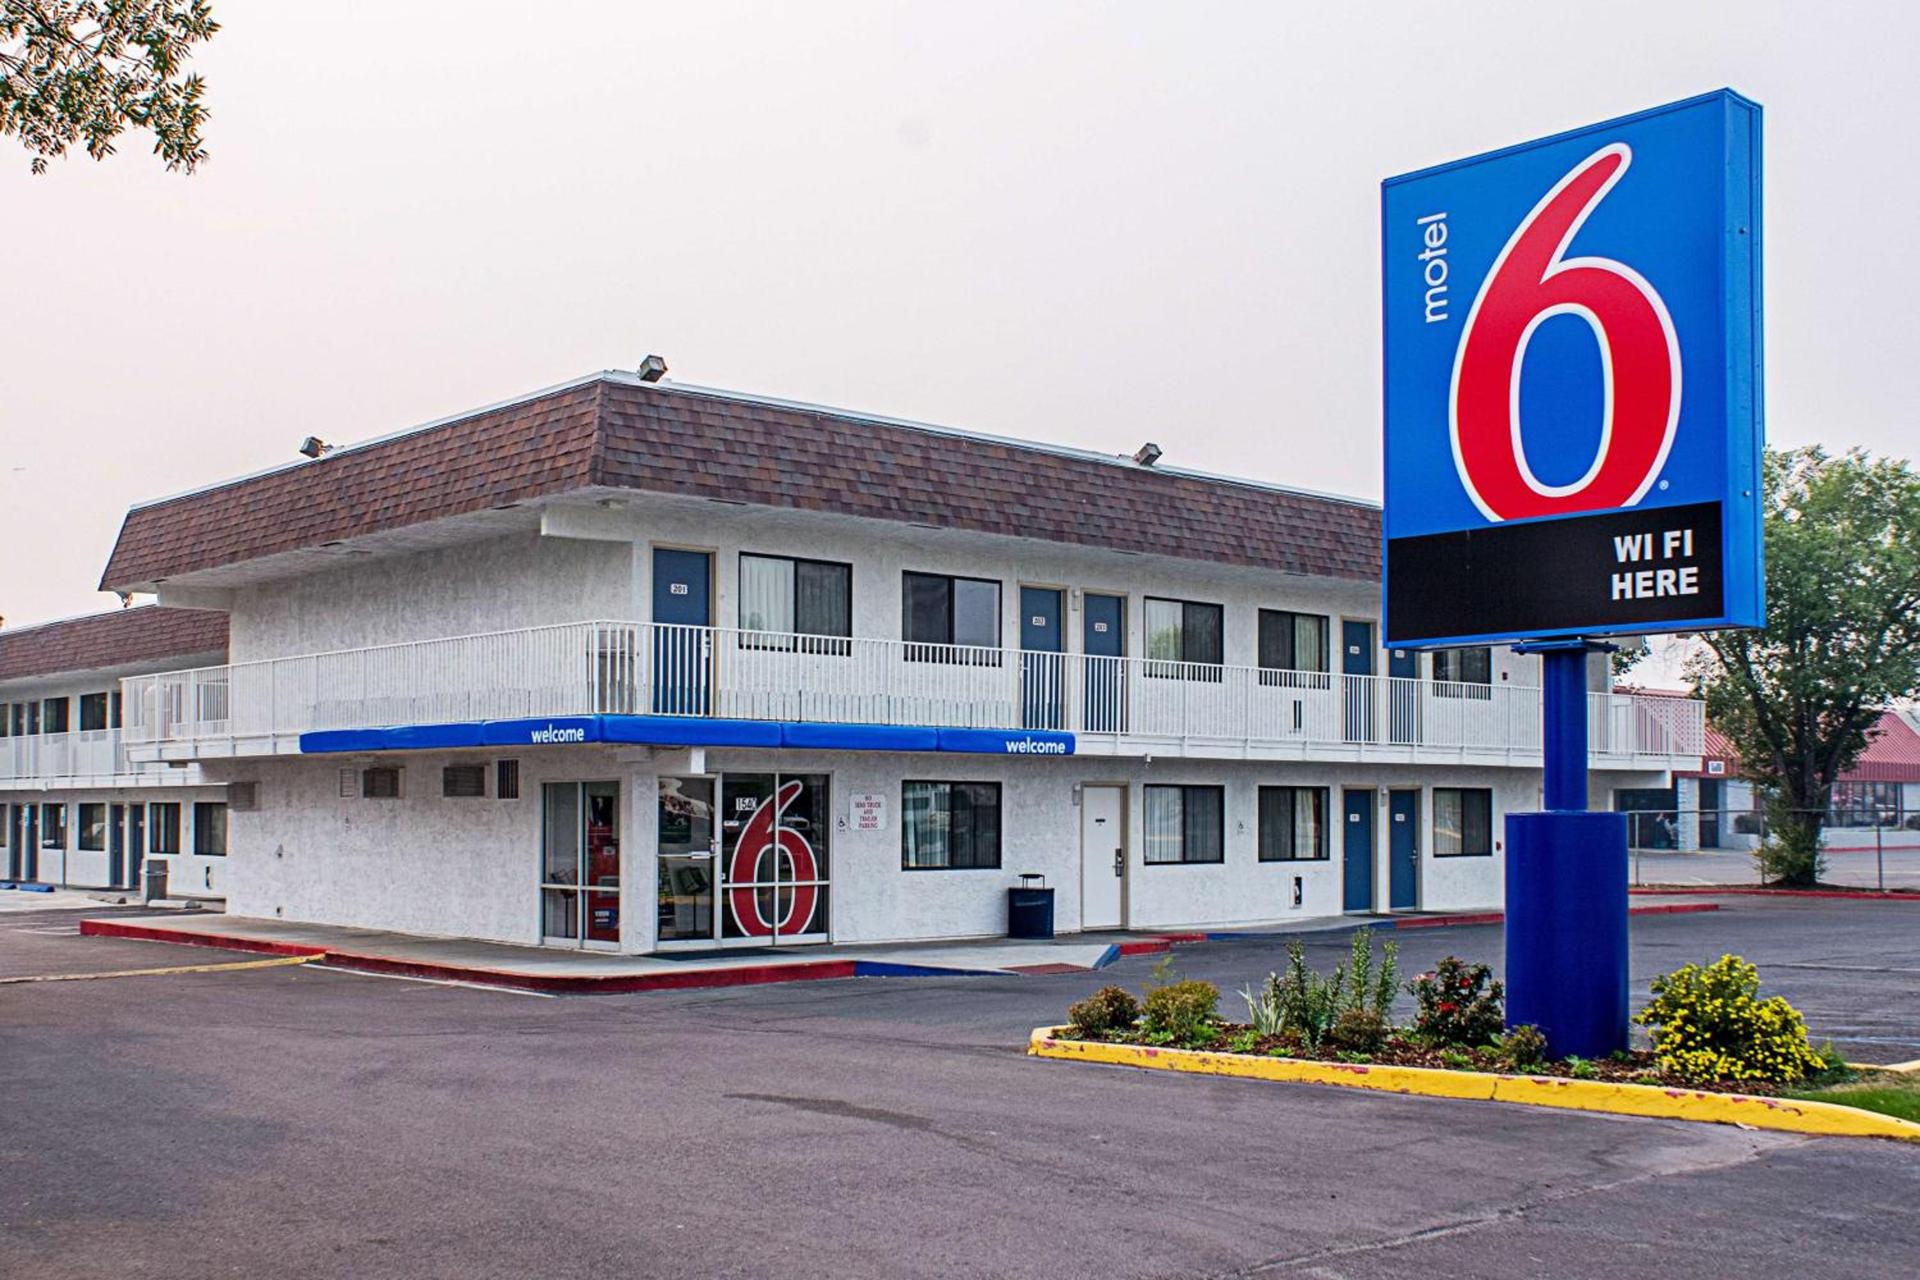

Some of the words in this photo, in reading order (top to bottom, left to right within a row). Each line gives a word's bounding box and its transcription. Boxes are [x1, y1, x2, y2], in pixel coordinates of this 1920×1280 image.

[1417, 212, 1448, 323] motel
[1448, 142, 1683, 522] 6
[1614, 533, 1653, 562] WI
[1663, 529, 1693, 558] FI
[1612, 566, 1699, 600] HERE
[531, 723, 585, 743] welcome
[1005, 736, 1066, 754] welcome
[729, 780, 818, 936] 6
